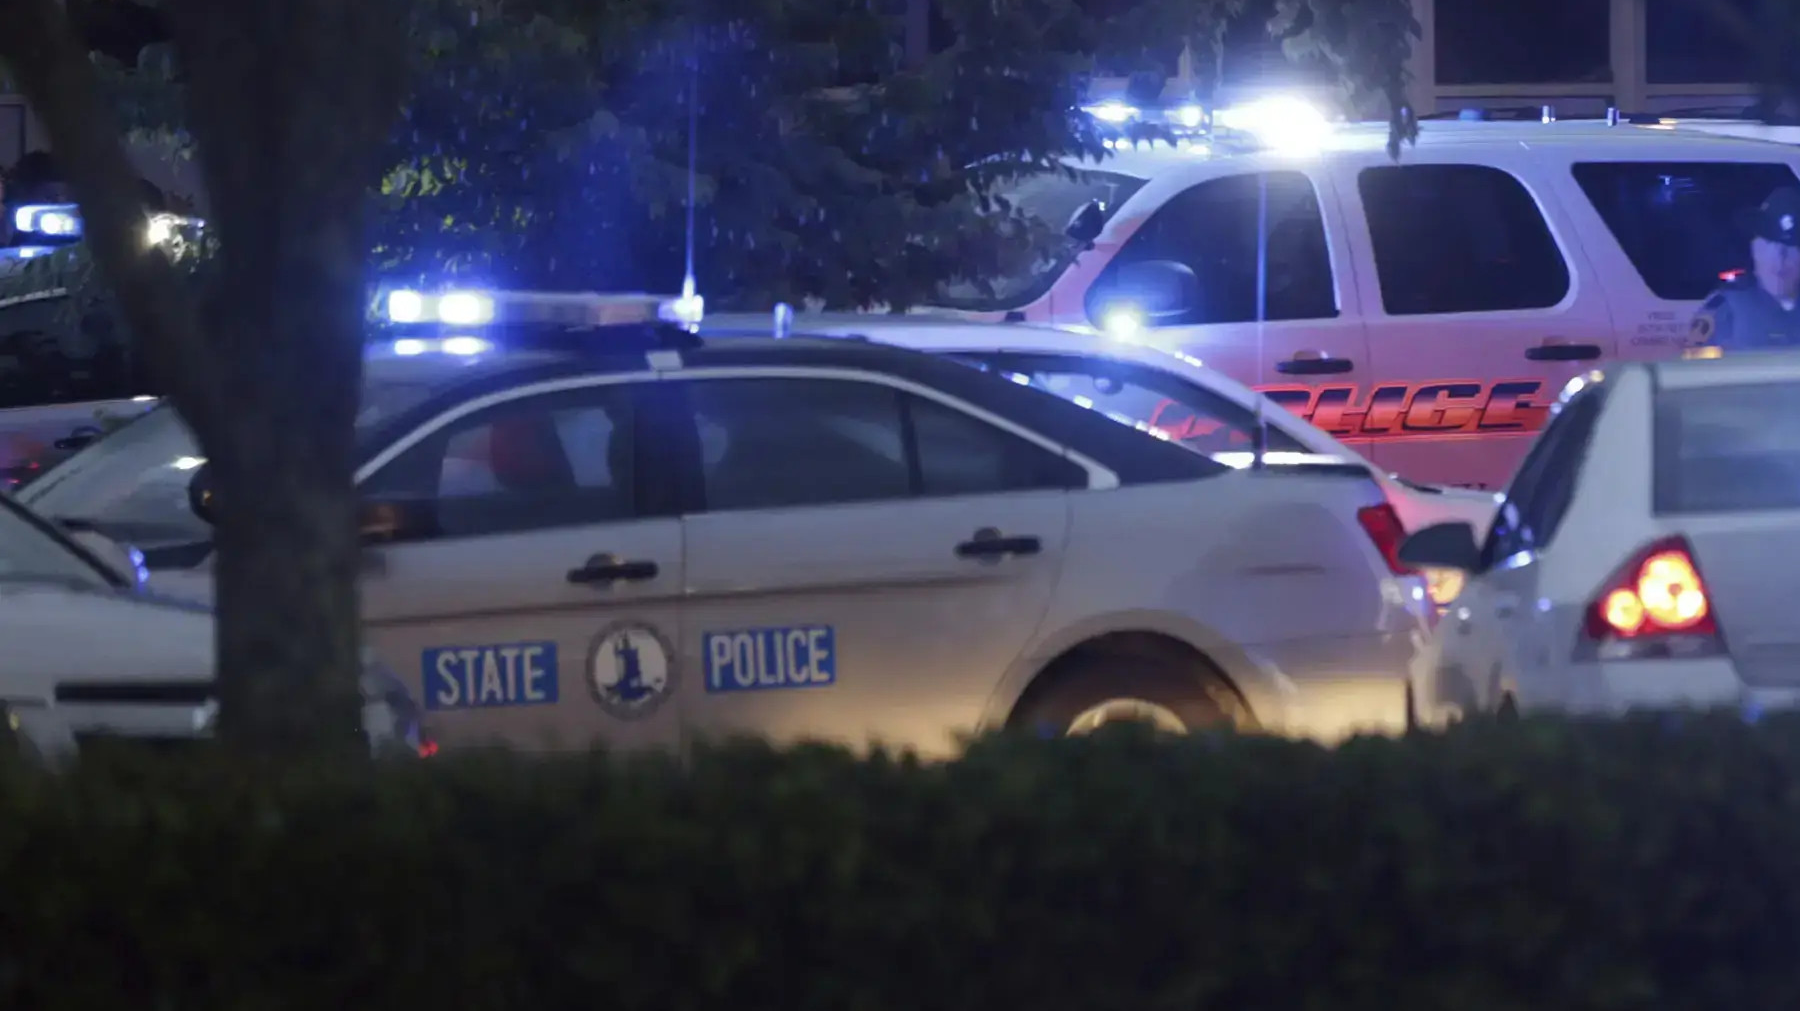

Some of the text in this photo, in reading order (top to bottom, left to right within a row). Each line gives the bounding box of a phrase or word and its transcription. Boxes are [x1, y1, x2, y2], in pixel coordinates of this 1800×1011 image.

[1152, 377, 1547, 442] LICE
[434, 628, 831, 706] STATE POLICE
